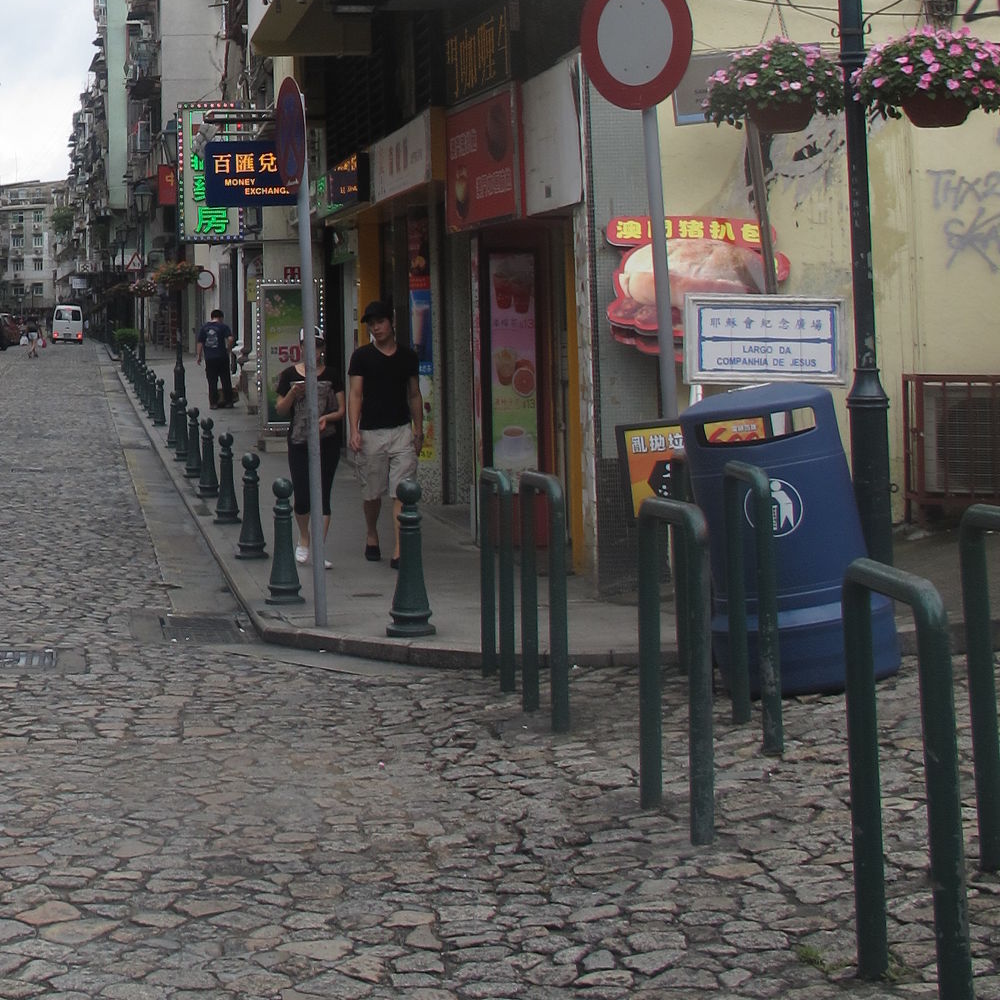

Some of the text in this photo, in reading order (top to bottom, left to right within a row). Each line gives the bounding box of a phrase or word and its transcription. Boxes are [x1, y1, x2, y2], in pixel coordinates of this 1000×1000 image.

[224, 178, 256, 186] MONEY
[244, 187, 290, 195] EXCHANG
[742, 345, 792, 354] LARGO DA
[716, 357, 817, 368] COMPANHIA DE JESUS
